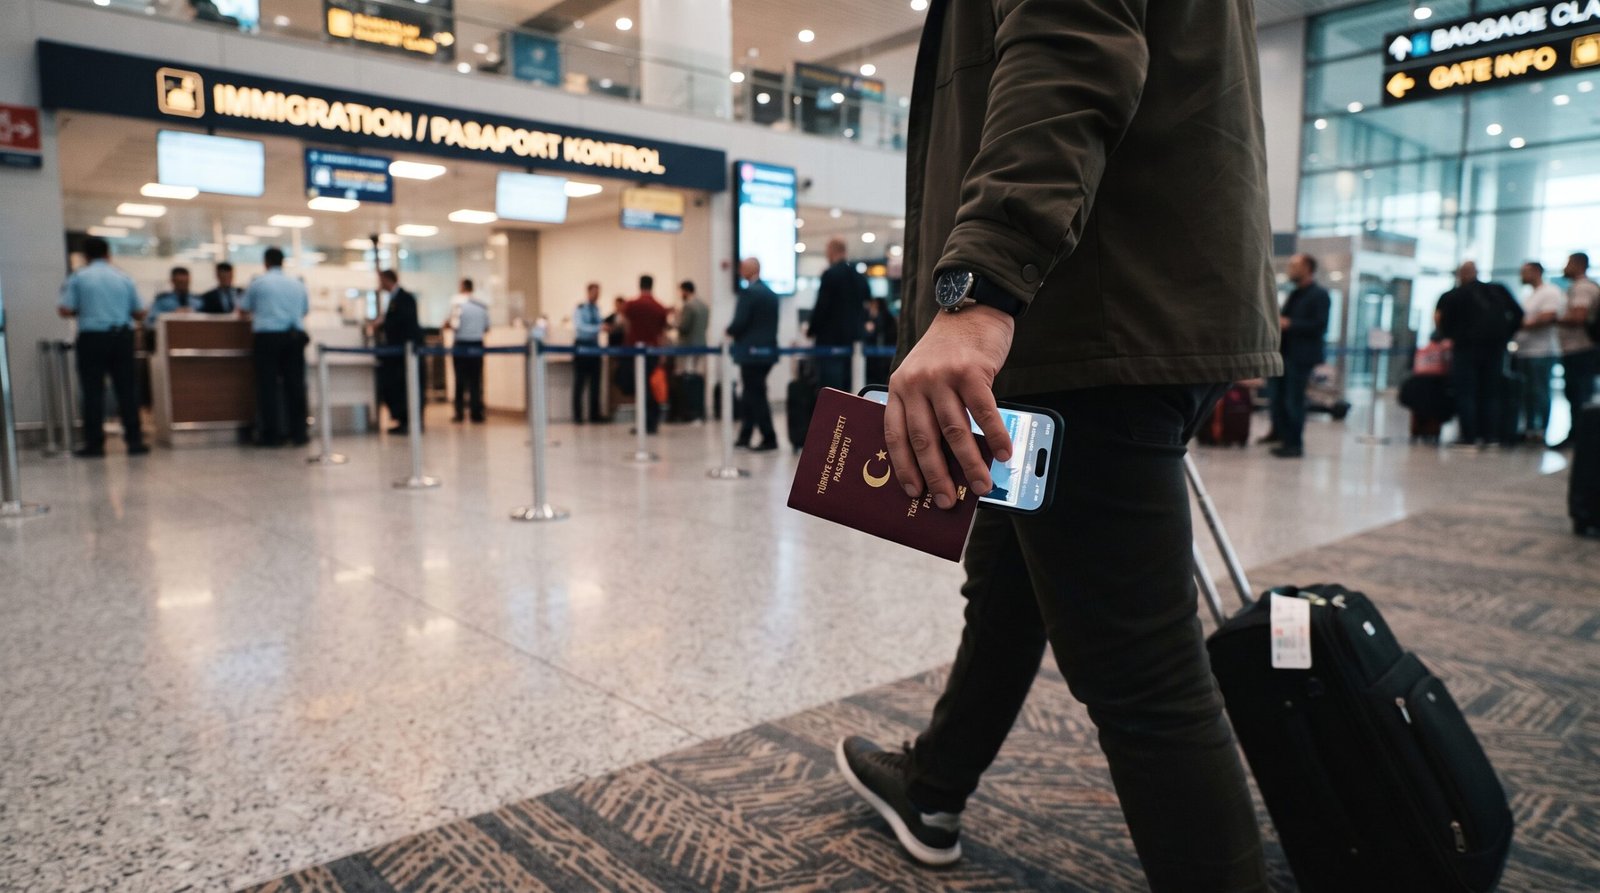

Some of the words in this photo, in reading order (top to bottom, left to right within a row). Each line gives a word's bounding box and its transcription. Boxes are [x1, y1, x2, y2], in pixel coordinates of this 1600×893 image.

[1429, 56, 1492, 90] GATE
[1494, 46, 1557, 78] INFO
[212, 83, 412, 141] IMMIGRATION
[416, 114, 428, 142] /
[430, 116, 562, 160] PASAPORT
[563, 136, 666, 175] KONTROL
[833, 437, 852, 482] PASAPORTU
